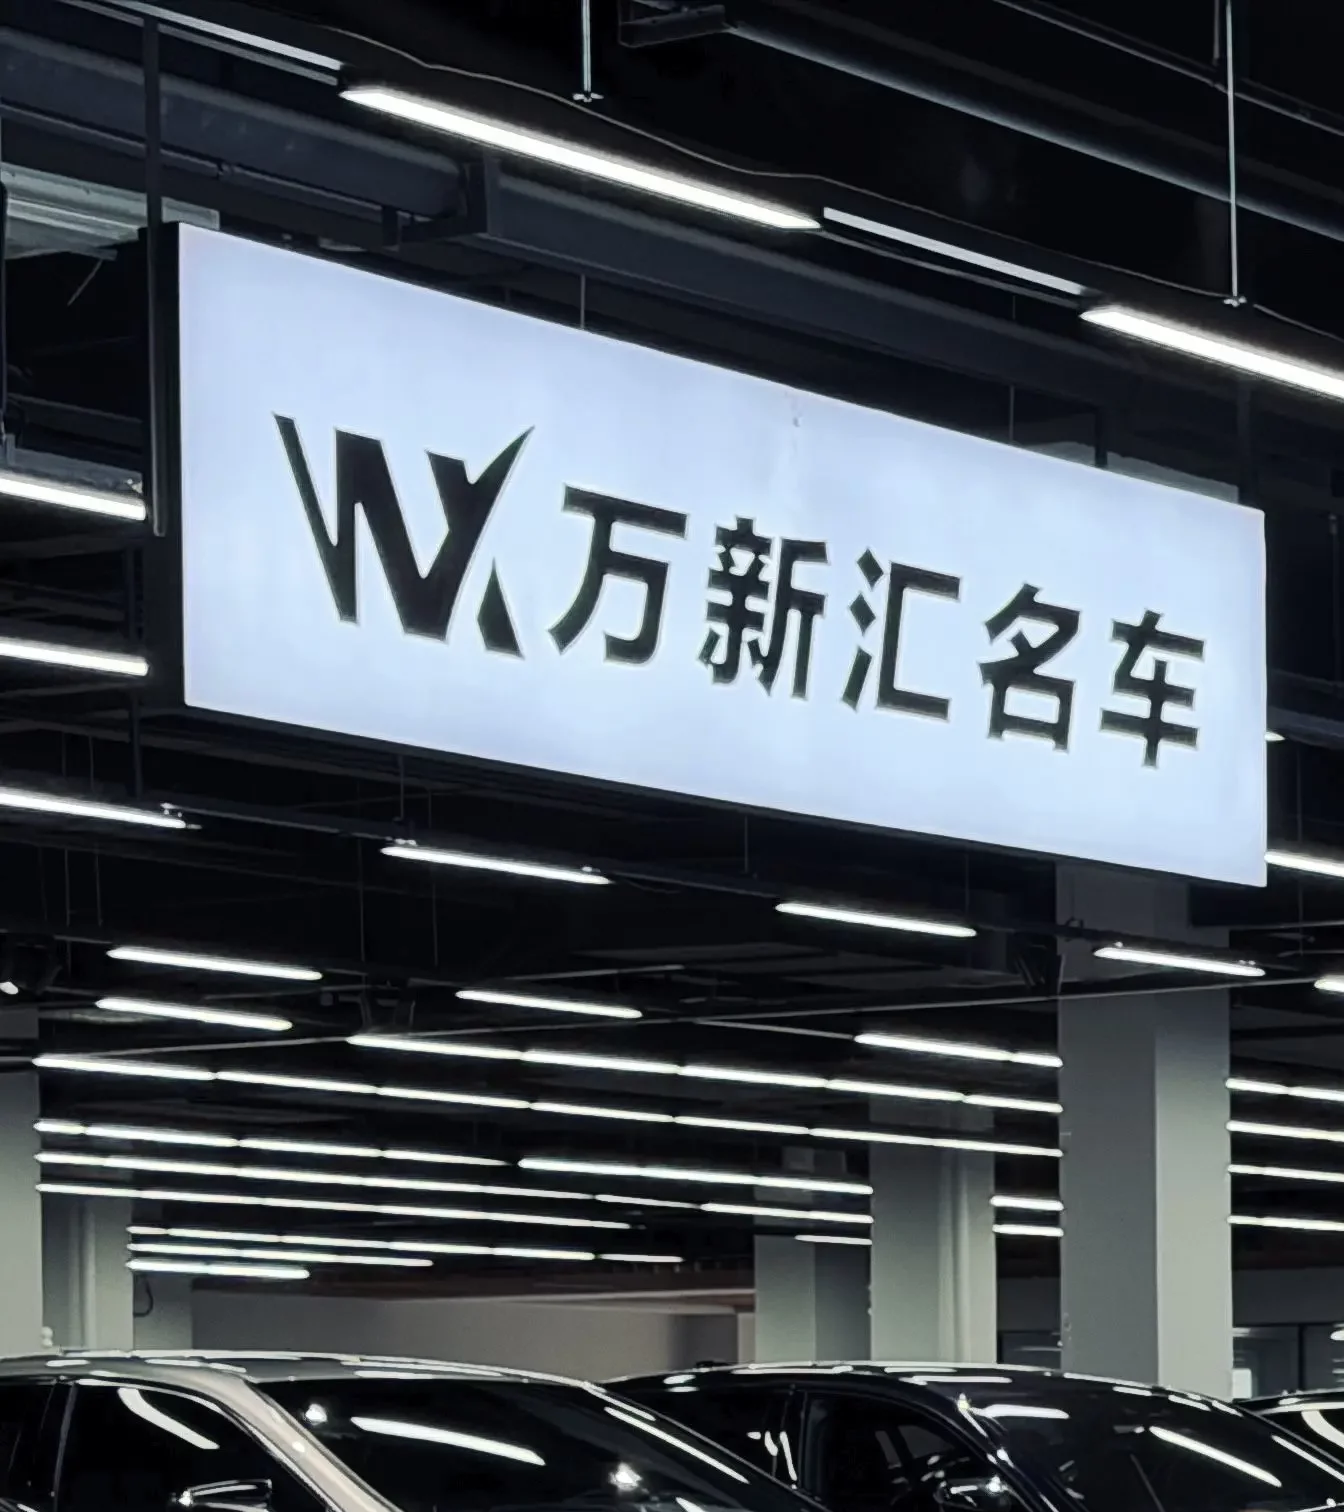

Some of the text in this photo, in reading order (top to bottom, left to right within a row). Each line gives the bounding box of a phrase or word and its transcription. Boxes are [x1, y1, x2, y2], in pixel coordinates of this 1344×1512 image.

[547, 484, 1206, 770] 万新汇名车
